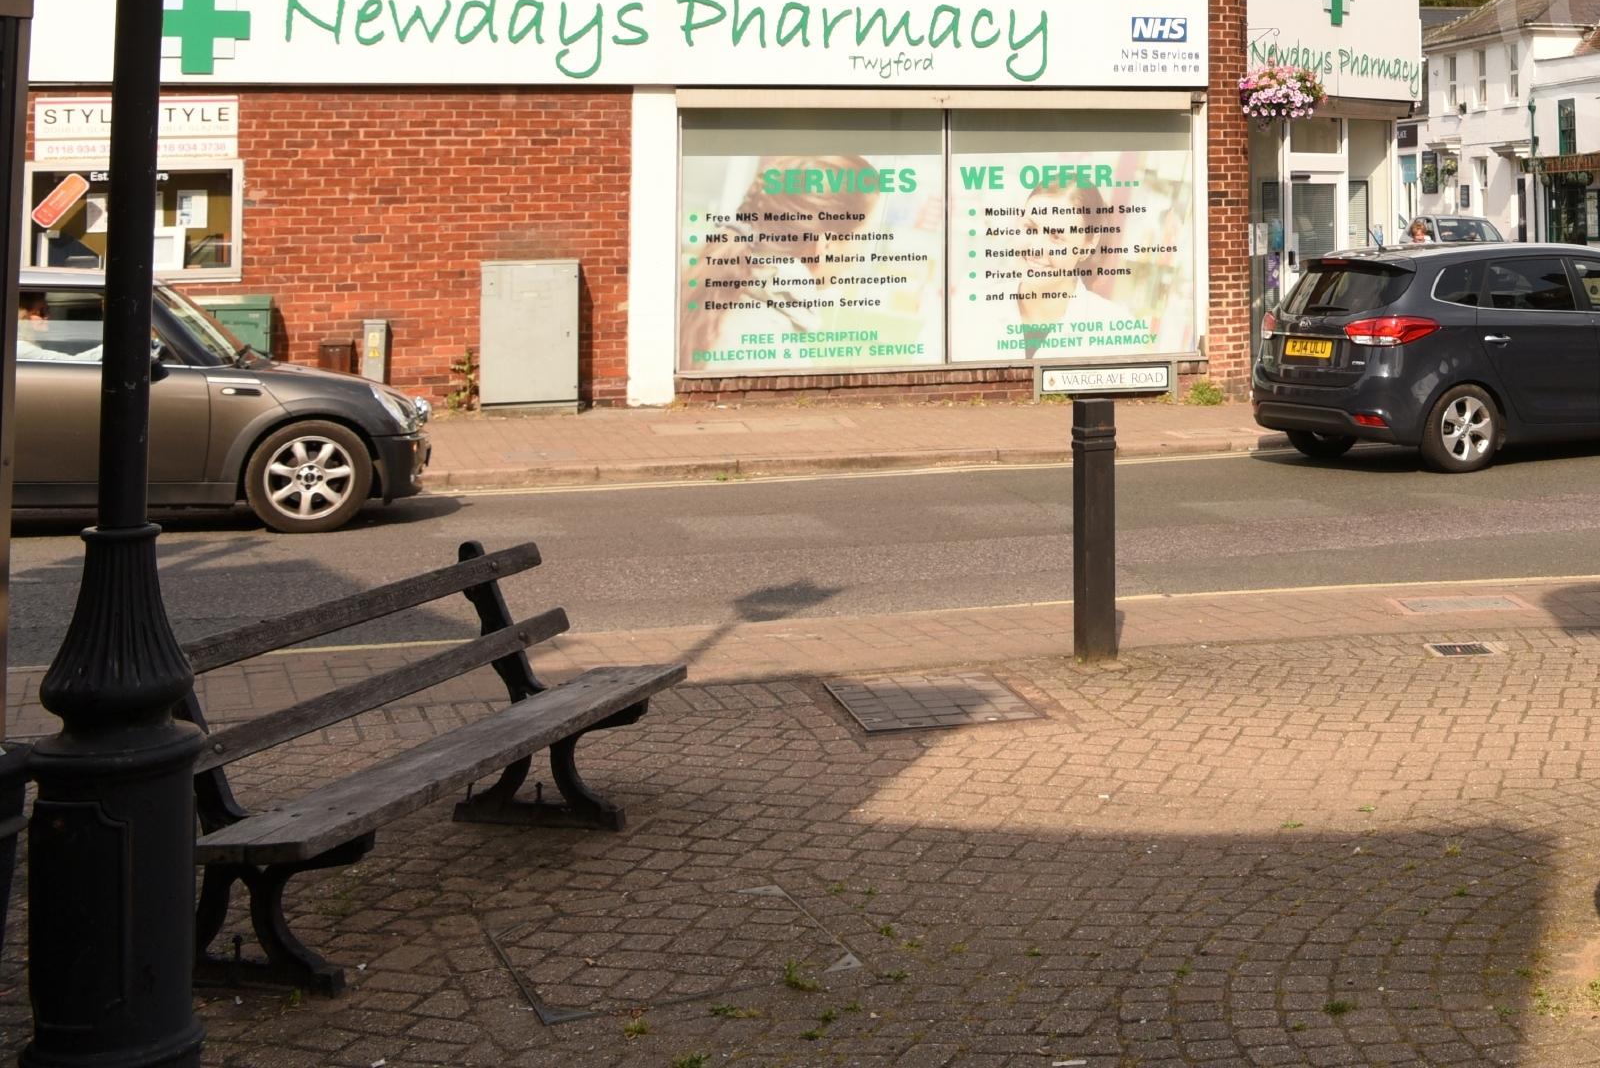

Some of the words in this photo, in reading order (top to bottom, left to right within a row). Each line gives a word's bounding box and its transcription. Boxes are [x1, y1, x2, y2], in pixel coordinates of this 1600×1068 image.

[1132, 17, 1186, 40] NHS
[1121, 49, 1148, 59] NHS
[1152, 49, 1200, 59] Services
[849, 52, 934, 79] Twyford
[1113, 62, 1168, 73] available
[1174, 63, 1200, 73] here
[1250, 38, 1333, 84] Newdays
[1338, 46, 1420, 95] Pharmacy
[44, 109, 112, 124] STYL
[164, 107, 230, 122] TYLE
[763, 168, 918, 195] SERVICES
[959, 165, 1004, 190] WE
[1019, 164, 1140, 190] OFFER...
[705, 213, 731, 222] Free
[736, 213, 759, 222] NHS
[764, 212, 813, 221] Medicine
[818, 212, 866, 223] Checkup
[985, 207, 1026, 218] Mobility
[1031, 206, 1048, 215] Aid
[1052, 206, 1091, 215] Rentals
[1096, 205, 1114, 214] and
[1118, 204, 1147, 213] Sales
[985, 227, 1021, 236] Advice
[1043, 226, 1065, 235] New
[1070, 224, 1121, 234] Medicines
[705, 234, 728, 243] NHS
[734, 234, 754, 242] and
[759, 233, 798, 242] Private
[803, 233, 820, 242] Flu
[825, 232, 894, 241] Vaccinations
[985, 248, 1044, 258] Residential
[1049, 247, 1067, 256] and
[1072, 246, 1096, 256] Care
[1100, 245, 1129, 254] Home
[1133, 244, 1178, 253] Services
[705, 256, 740, 265] Travel
[745, 255, 795, 265] Vaccines
[800, 255, 820, 264] and
[825, 254, 865, 263] Malaria
[870, 253, 928, 262] Prevention
[985, 270, 1022, 279] Private
[1027, 268, 1092, 278] Consultation
[1097, 267, 1131, 276] Rooms
[705, 277, 767, 289] Emergency
[772, 276, 825, 286] Hormonal
[830, 275, 907, 286] Contraception
[985, 292, 1004, 301] and
[1009, 292, 1037, 301] much
[705, 300, 761, 310] Electronic
[767, 298, 834, 310] Prescription
[839, 298, 881, 308] Service
[1006, 322, 1064, 334] SUPPORT
[1070, 321, 1103, 333] YOUR
[1109, 319, 1149, 331] LOCAL
[741, 333, 775, 344] FREE
[781, 330, 878, 343] PRESCRIPTION
[997, 337, 1083, 350] INDEPENDENT
[1089, 333, 1157, 346] PHARMACY
[691, 348, 776, 362] COLLECTION
[783, 348, 792, 358] &
[799, 346, 862, 358] DELIVERY
[868, 344, 925, 356] SERVICE
[1061, 373, 1126, 387] WARGRAVE
[1131, 372, 1164, 384] ROAD
